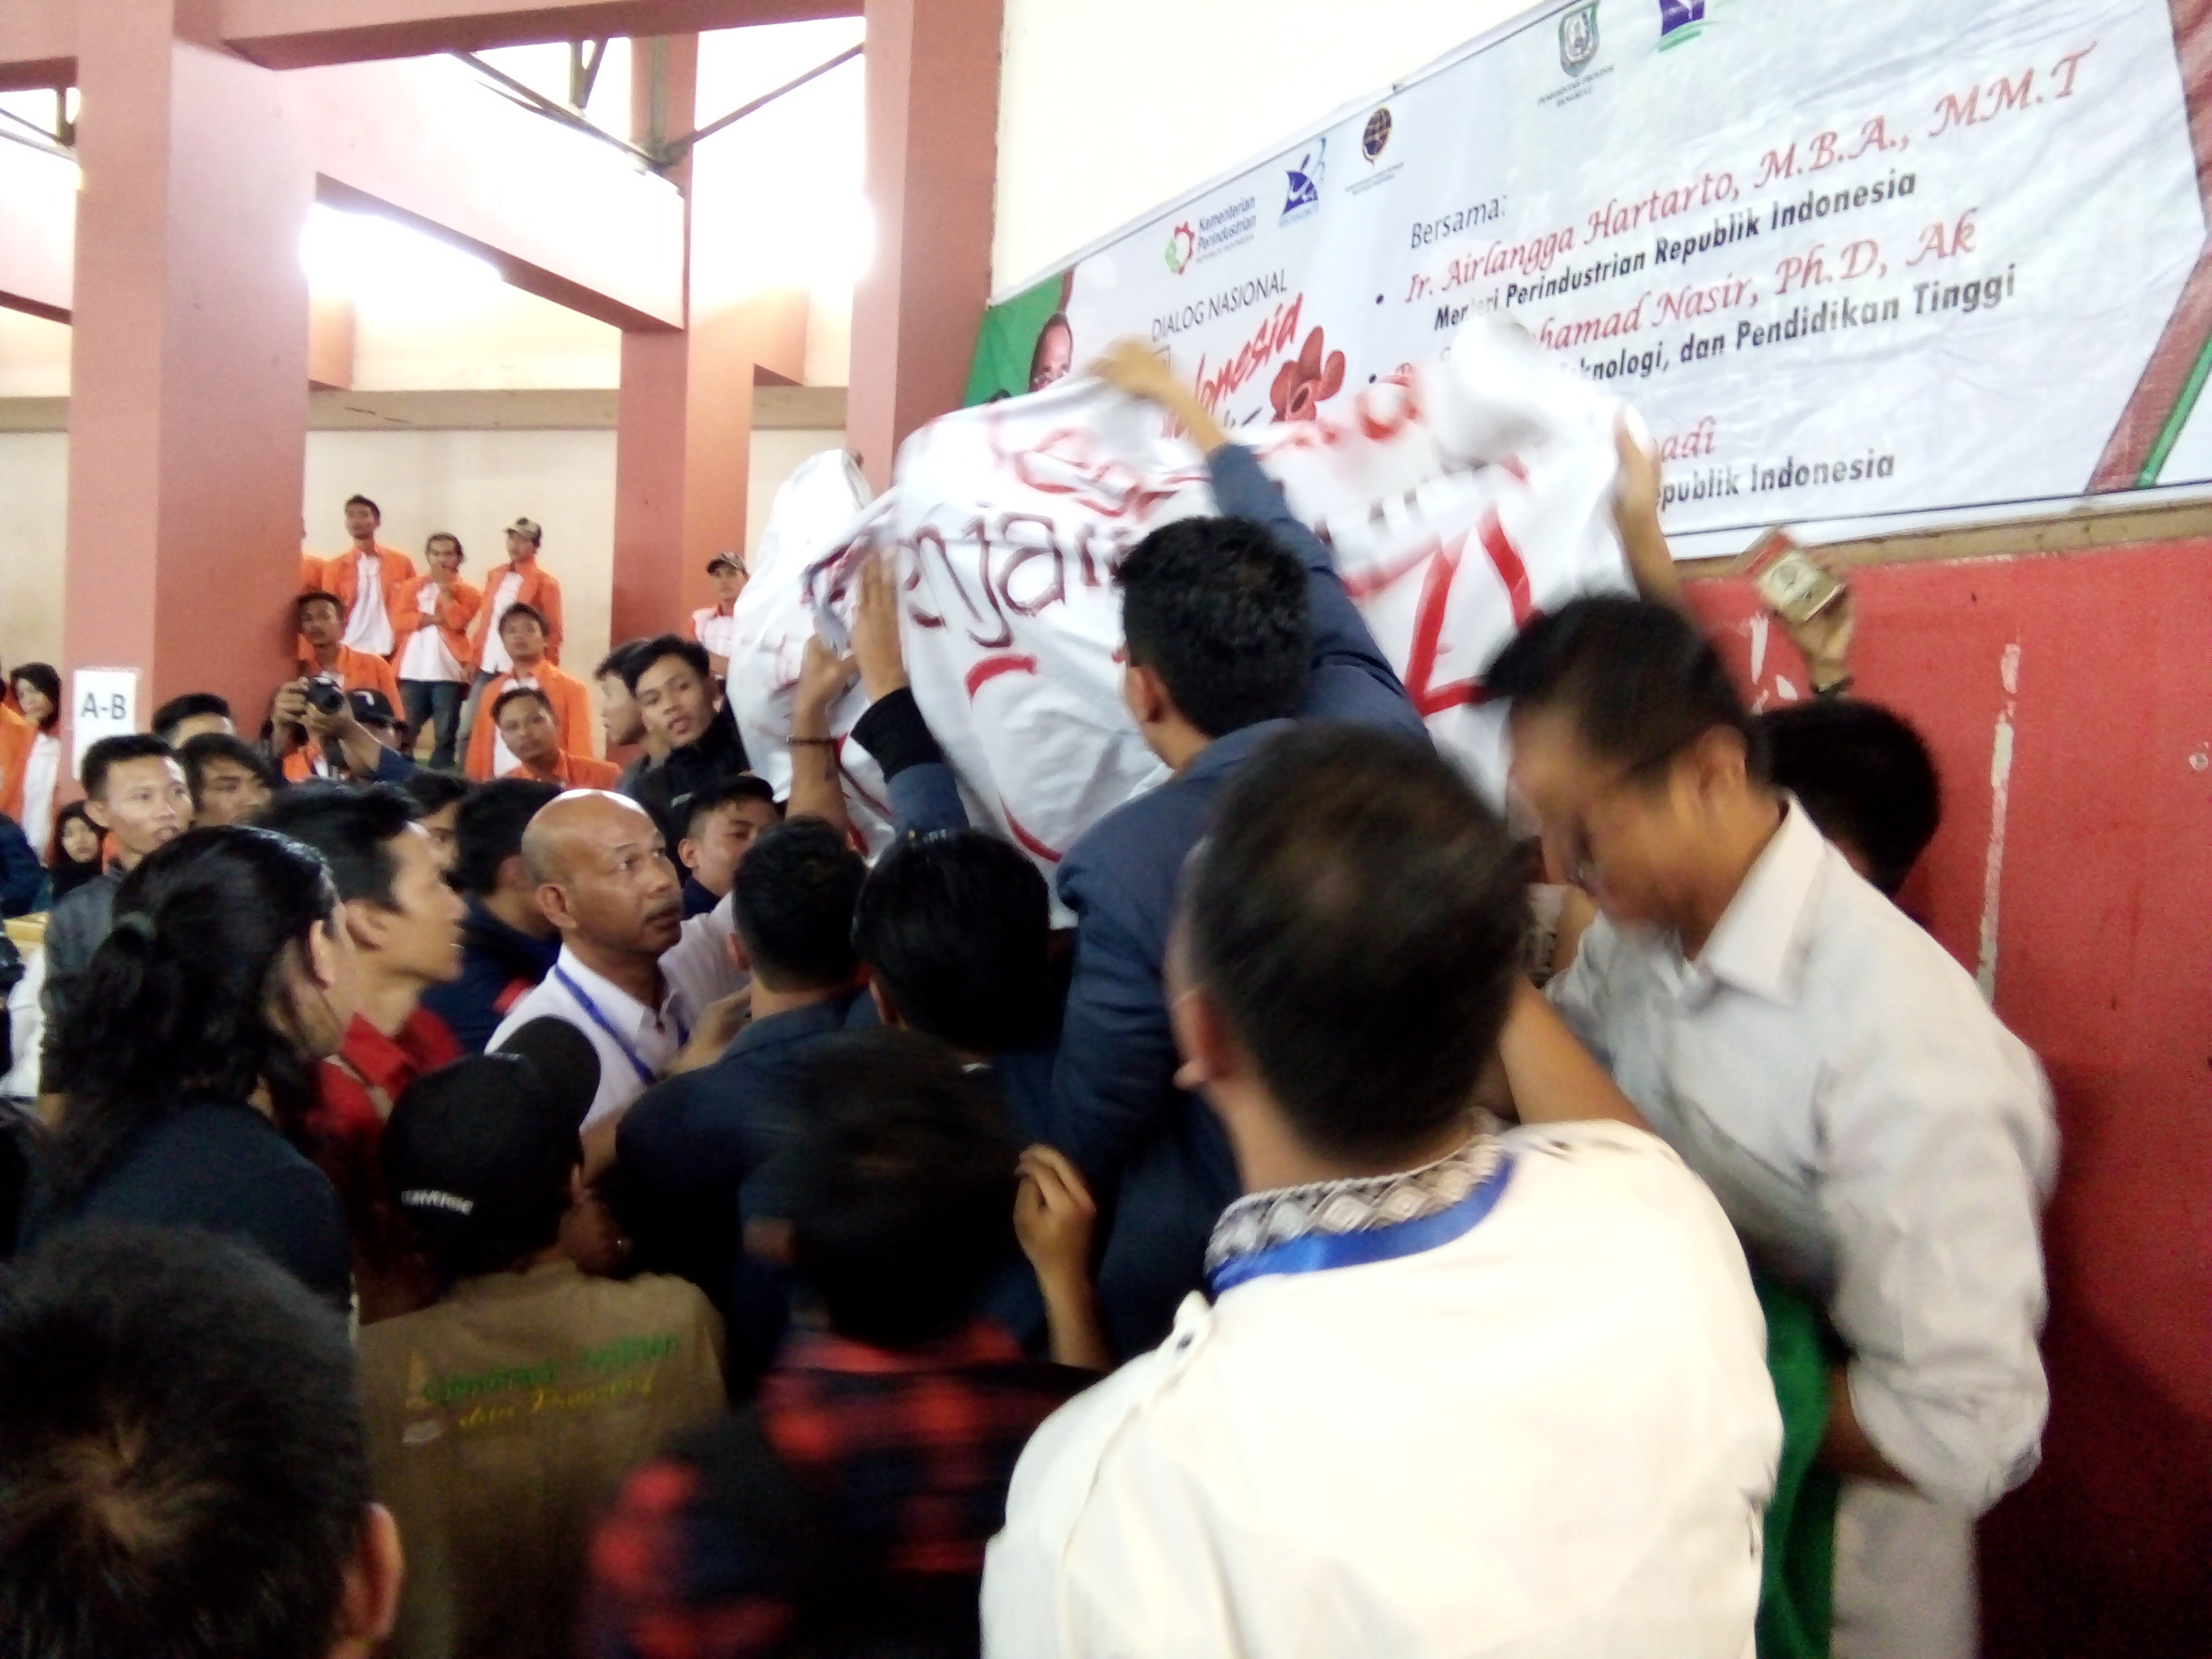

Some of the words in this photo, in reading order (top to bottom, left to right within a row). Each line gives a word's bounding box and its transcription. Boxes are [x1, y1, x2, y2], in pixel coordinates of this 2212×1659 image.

[1405, 273, 1433, 303] Ir.
[1442, 226, 1576, 292] Airlangga
[1583, 172, 1740, 245] Hartarto,
[1755, 115, 1910, 189] M.B.A.,
[1928, 40, 2097, 138] MM.T
[1410, 194, 1507, 249] Bersama:
[1506, 251, 1646, 308] Perindustrian
[1654, 207, 1761, 265] Republik
[1770, 168, 1917, 230] Indonesia
[1153, 300, 1204, 342] DIALOG
[1208, 269, 1288, 321] NASIONAL
[1537, 291, 1652, 351] hamad
[1652, 272, 1759, 327] Nasir,
[1905, 206, 1979, 267] Ak
[1680, 332, 1726, 364] dan
[1736, 295, 1900, 351] Pendidikan
[1913, 262, 2017, 314] Tinggi
[1661, 464, 1740, 512] publik
[1750, 447, 1895, 493] Indonesia
[80, 691, 127, 720] A-B
